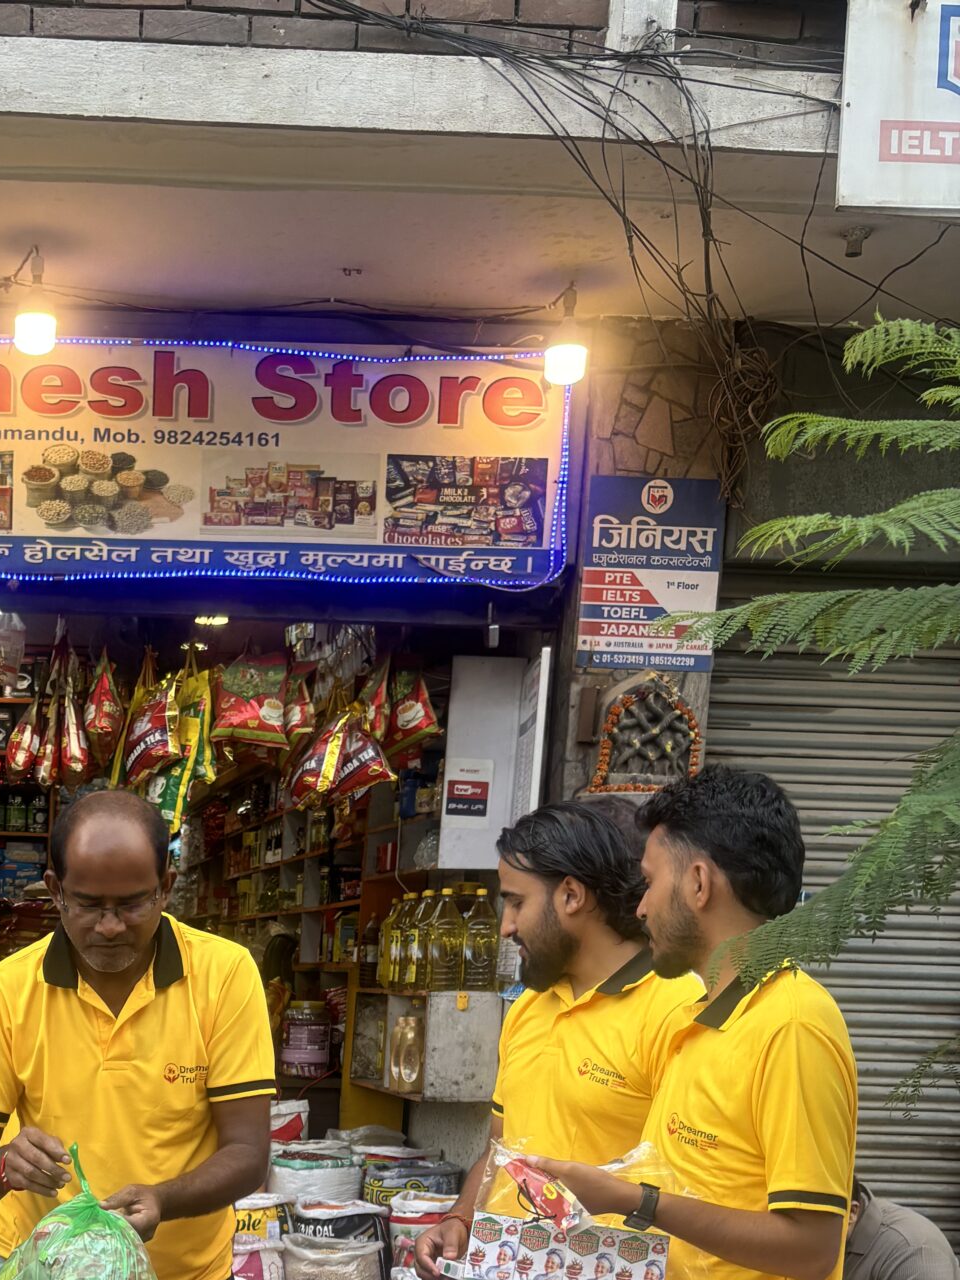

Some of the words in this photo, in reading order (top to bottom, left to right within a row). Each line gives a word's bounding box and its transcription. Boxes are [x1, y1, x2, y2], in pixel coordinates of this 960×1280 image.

[891, 129, 960, 156] IELT
[252, 352, 543, 426] Store
[93, 427, 146, 445] Mob.
[153, 429, 280, 447] 9824254161
[384, 532, 463, 546] Chocolates
[593, 515, 717, 553] जिनियस
[23, 539, 139, 563] होलसेल
[151, 547, 212, 566] तथा
[593, 551, 647, 566] एजुकेशनल
[605, 573, 632, 584] PTE
[677, 582, 699, 590] Floor
[602, 590, 640, 602] IELTS
[601, 606, 647, 619] TOEFL
[613, 641, 643, 649] AUSTRALIA
[145, 731, 161, 745] TEA
[359, 745, 375, 762] TEA
[589, 1072, 609, 1087] Trust
[591, 1063, 626, 1081] Dreamer
[678, 1120, 718, 1142] Dreamer
[677, 1132, 699, 1148] Trust
[316, 1225, 334, 1237] DAL
